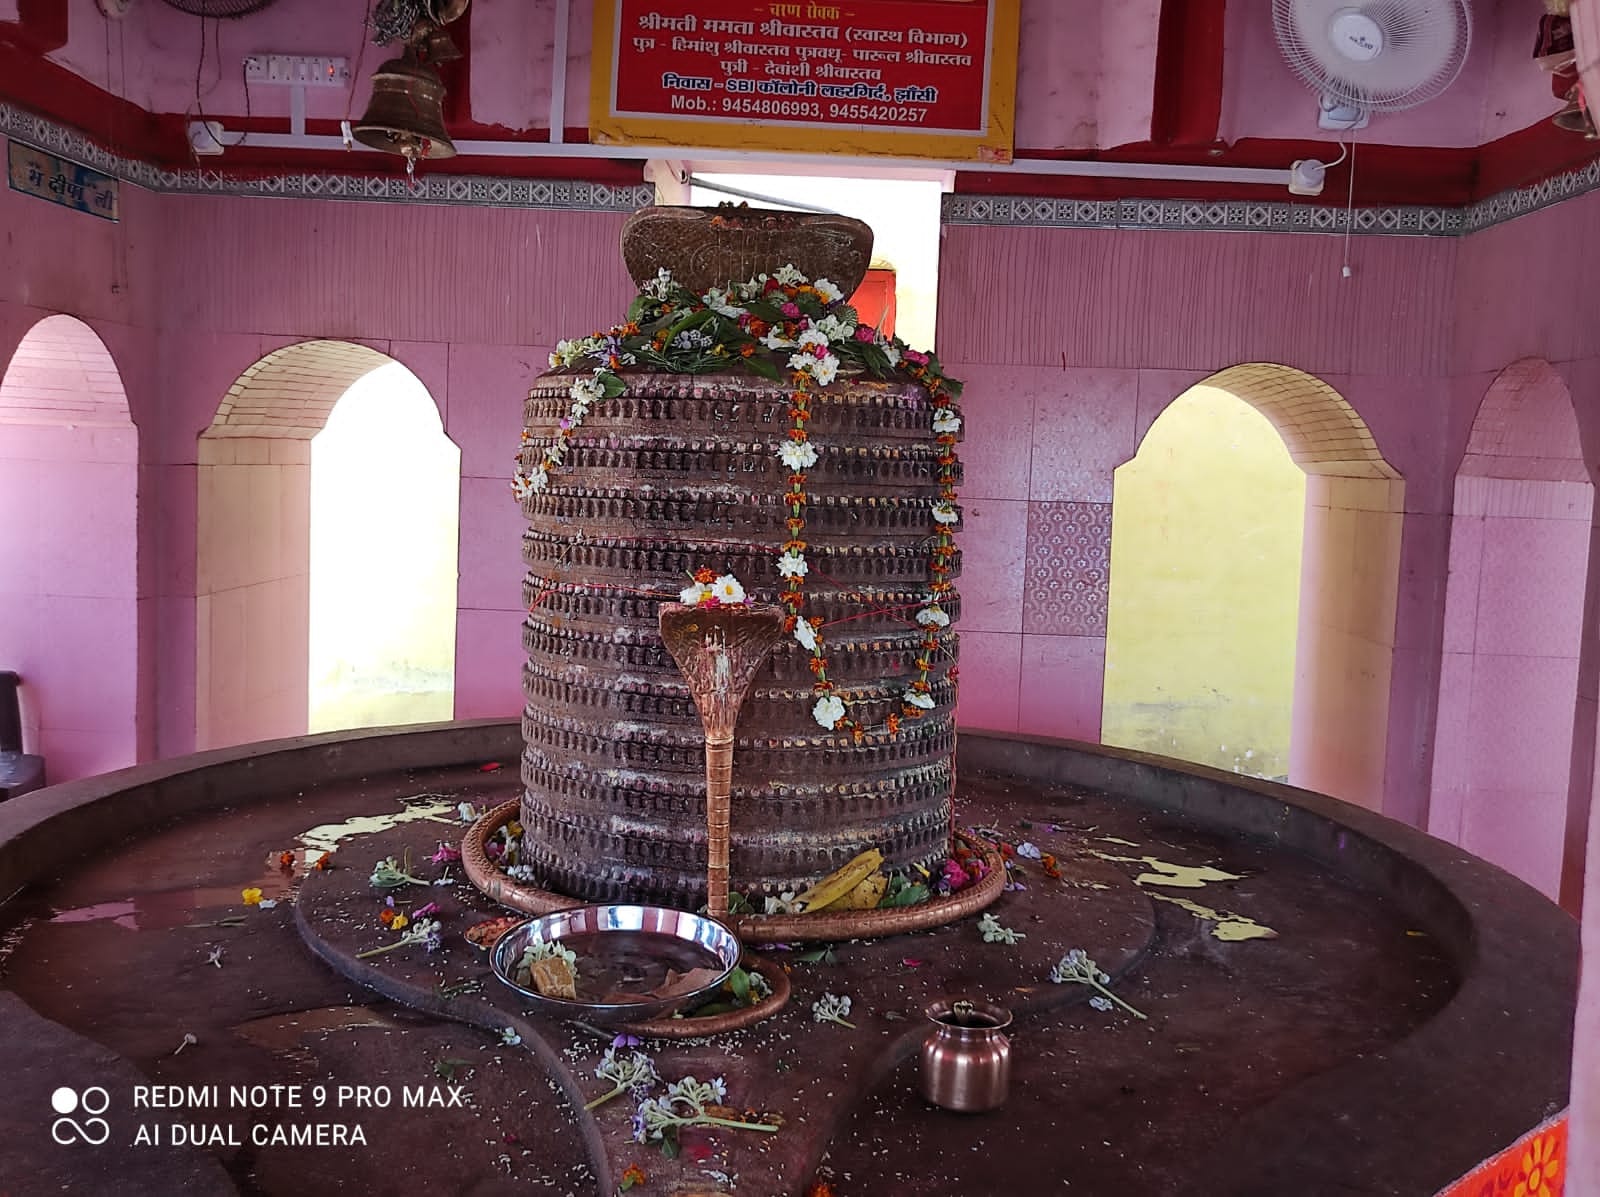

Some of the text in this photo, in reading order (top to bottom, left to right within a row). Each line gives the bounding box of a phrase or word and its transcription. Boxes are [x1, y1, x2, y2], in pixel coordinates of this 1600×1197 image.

[639, 12, 697, 33] श्रीमती
[703, 19, 755, 35] ममता
[760, 19, 840, 40] श्रीवास्तव
[908, 28, 968, 48] विभाग)
[672, 35, 720, 56] हिमांशु
[724, 39, 791, 57] श्रीवास्तव
[905, 49, 972, 67] श्रीवास्तव
[720, 58, 748, 76] पुत्री
[764, 60, 810, 77] देवांशी
[815, 63, 881, 81] श्रीवास्तव
[662, 72, 712, 91] निवास
[726, 79, 756, 94] SBI
[757, 79, 817, 96] कॉलोनी
[894, 85, 938, 104] झाँसी
[671, 95, 928, 123] Mob.: 9454806993, 9455420257
